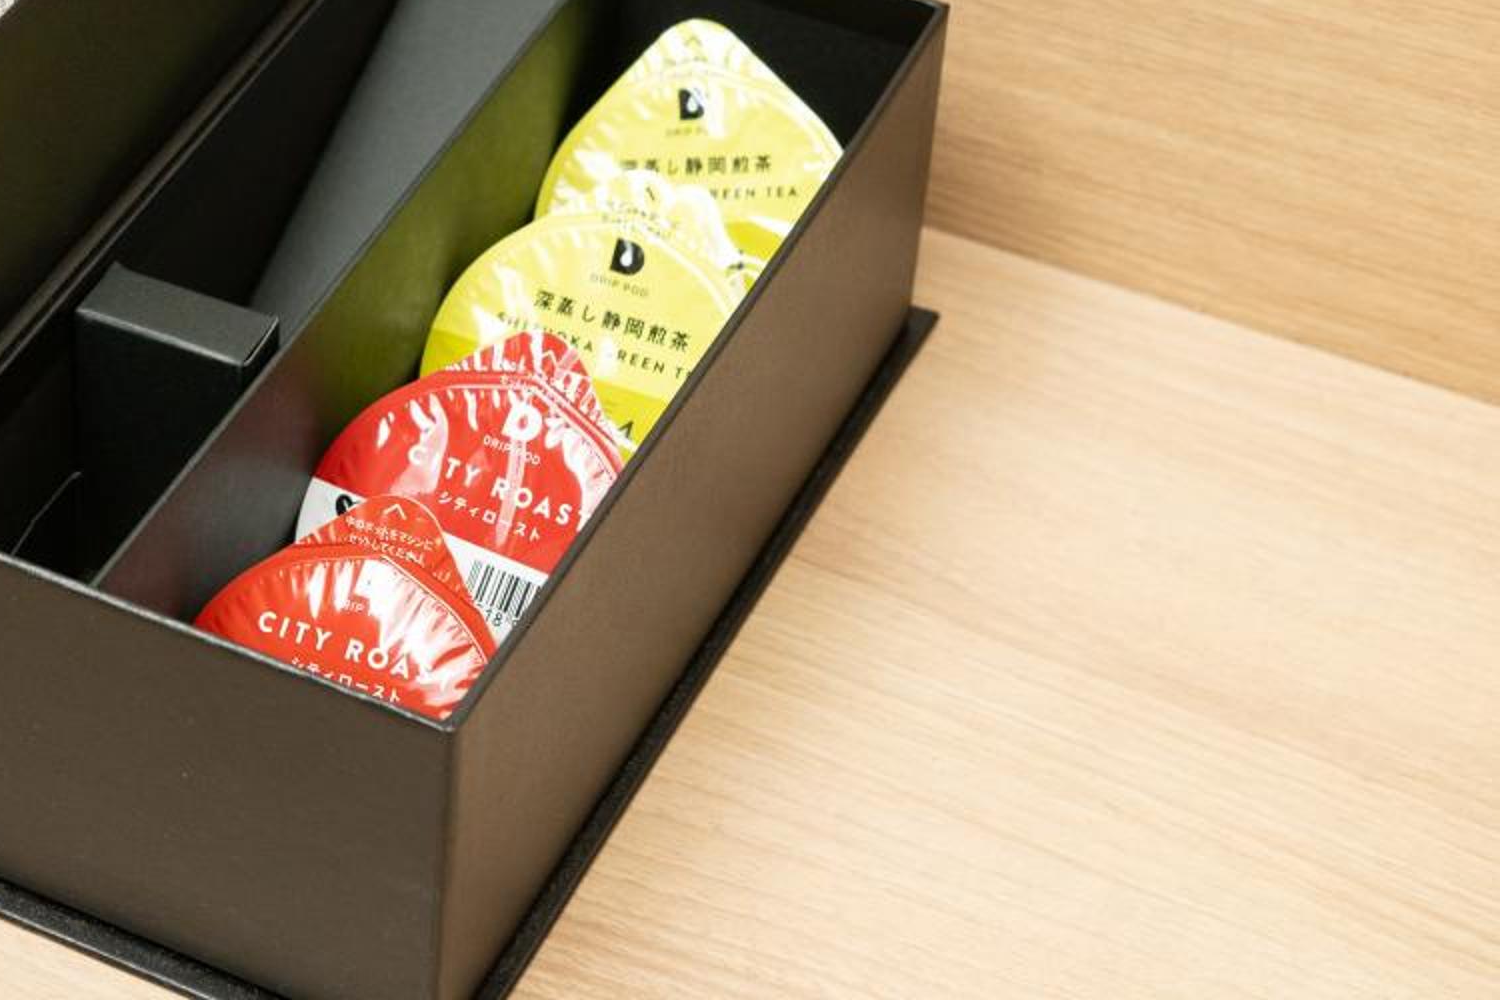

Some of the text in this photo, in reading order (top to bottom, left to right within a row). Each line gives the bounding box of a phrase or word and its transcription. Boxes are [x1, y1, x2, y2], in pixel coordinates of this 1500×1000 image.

[709, 186, 799, 201] EEN TEA
[590, 272, 650, 299] DRIP POD
[497, 311, 594, 352] SHIOKA
[607, 346, 666, 375] REEN
[533, 290, 690, 353] 深蒸し静岡煎茶
[408, 444, 482, 488] CTY
[258, 611, 444, 692] CITY ROA
